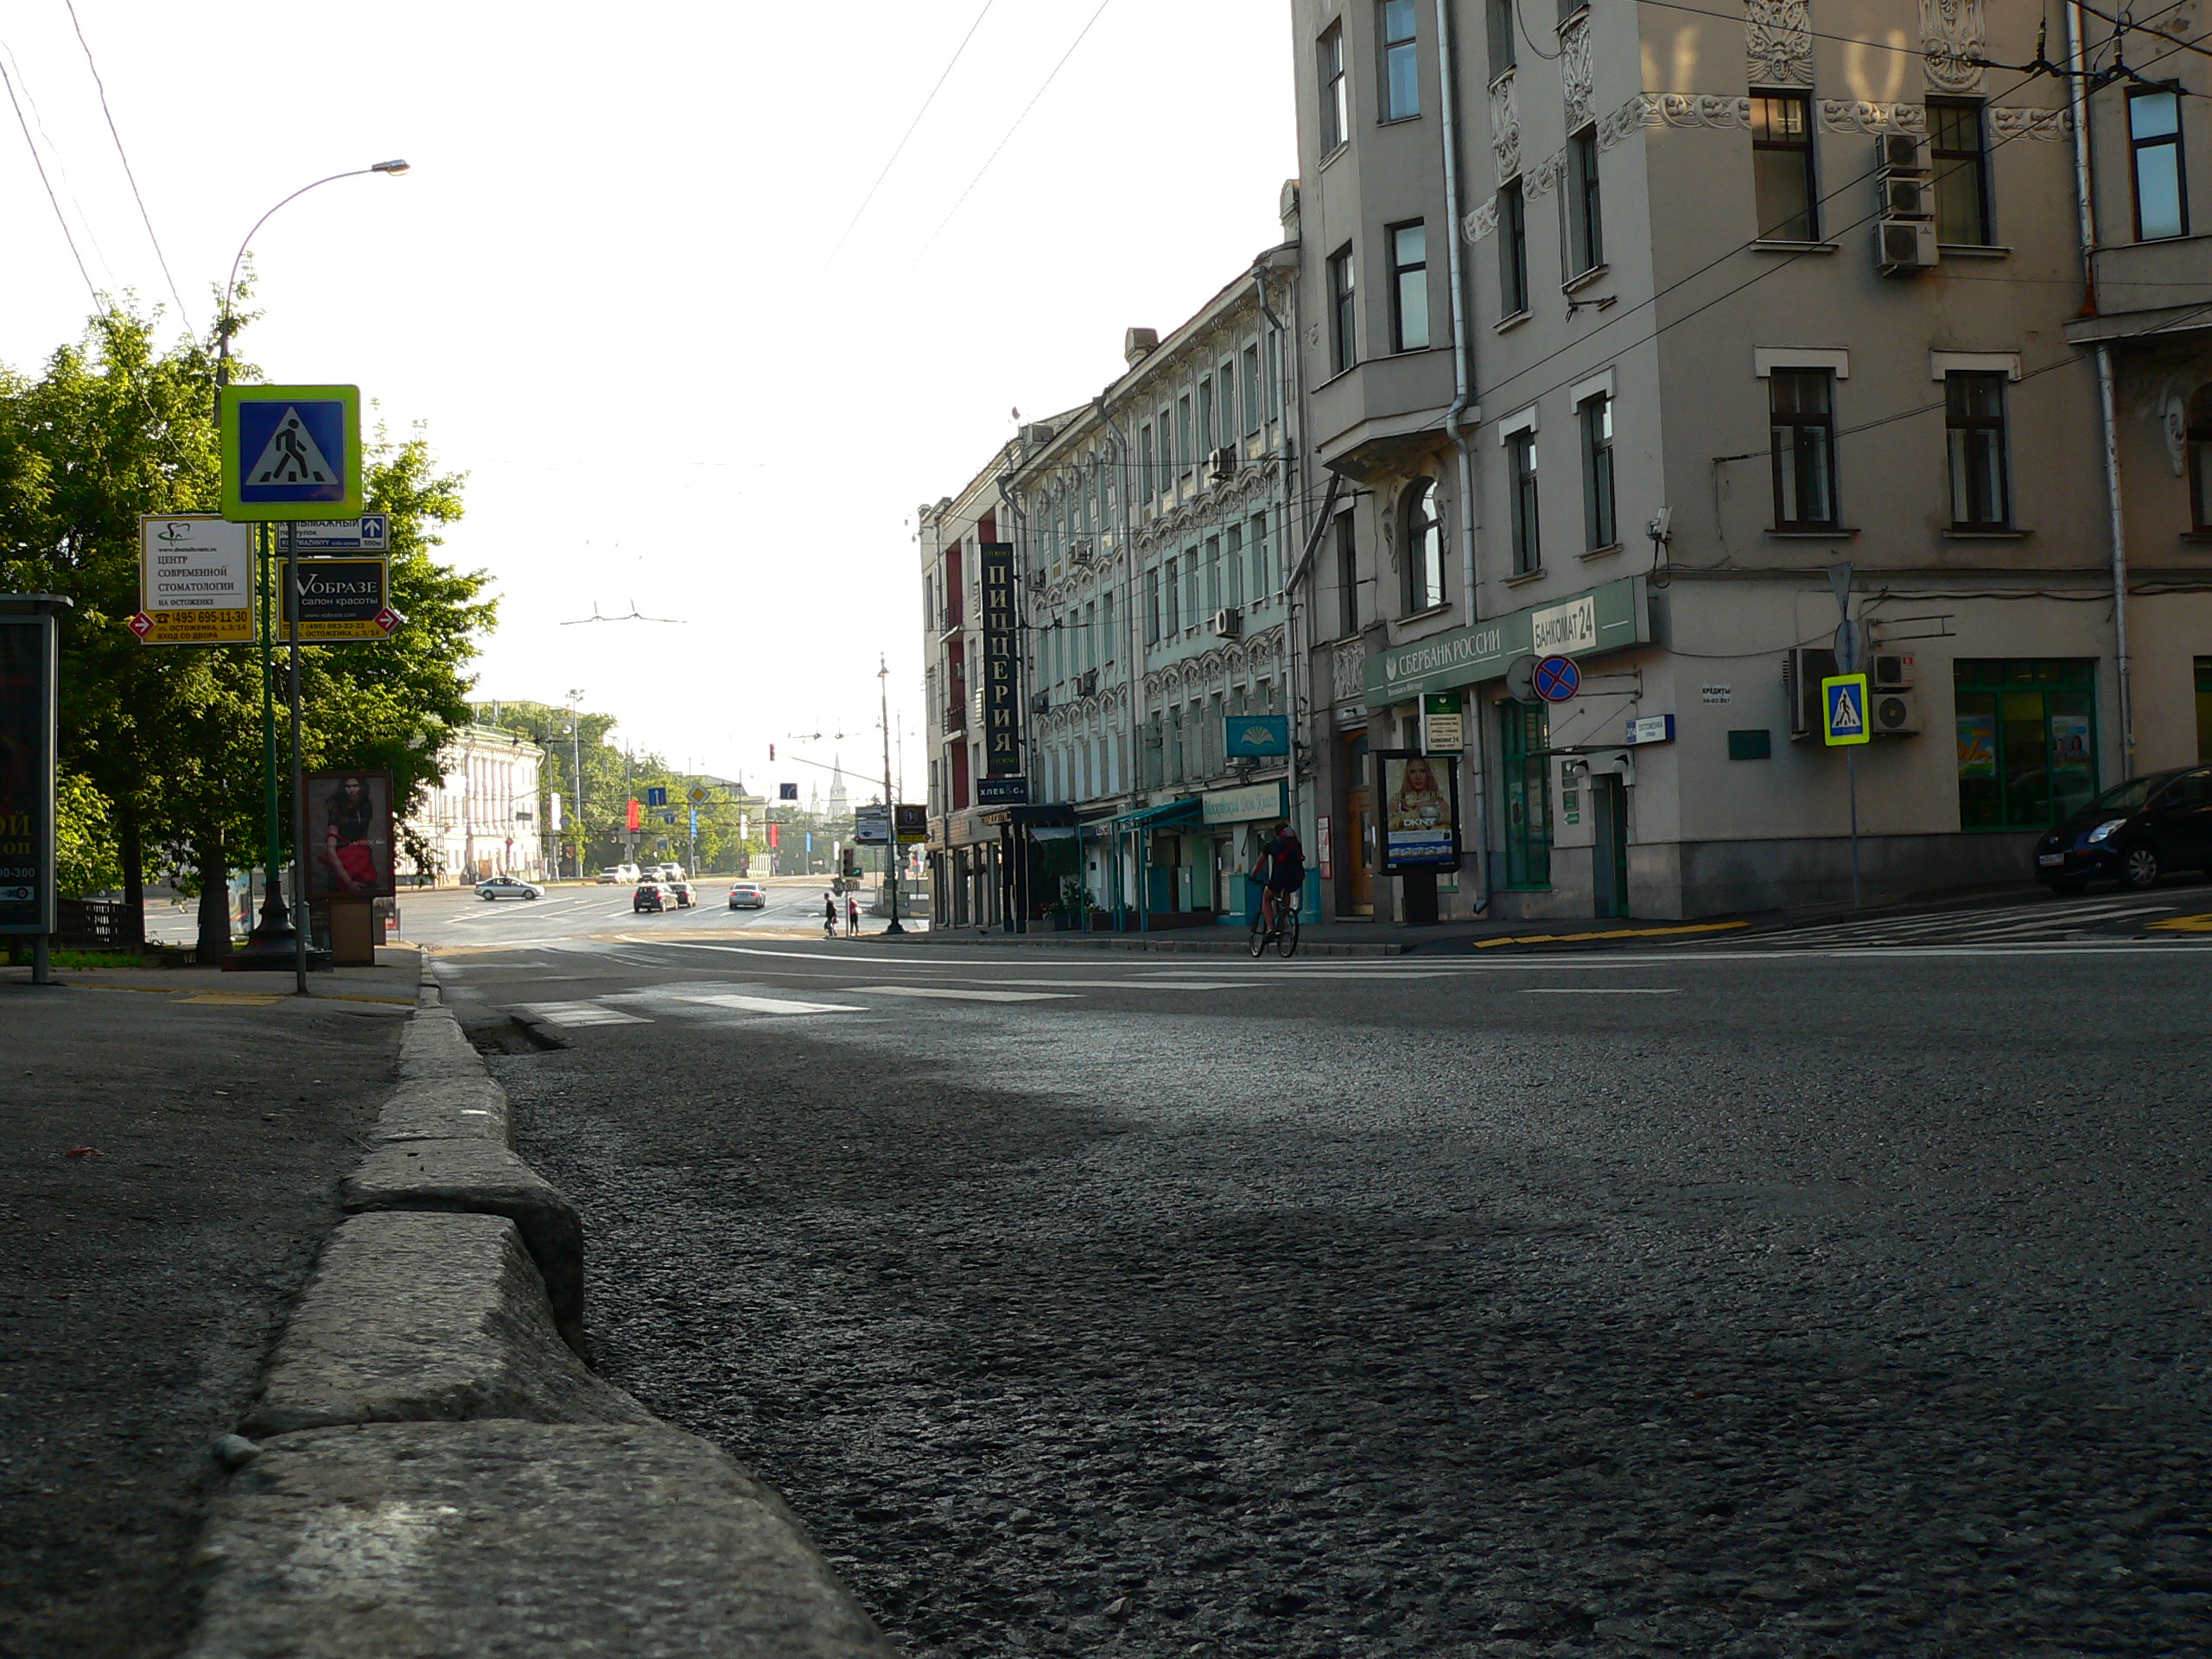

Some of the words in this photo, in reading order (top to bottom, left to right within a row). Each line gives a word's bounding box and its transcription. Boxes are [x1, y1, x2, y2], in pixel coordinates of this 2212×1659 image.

[158, 556, 188, 565] ЦЕНТР
[158, 566, 228, 578] СОВРЕМЕННОЙ
[158, 582, 234, 592] СТОМАТОЛОГИИ
[335, 597, 378, 607] красоты
[173, 612, 195, 623] (495)
[198, 611, 247, 623] 695-11-30
[1535, 613, 1578, 649] БАНКОМАТ
[1578, 603, 1593, 640] 24
[1399, 642, 1453, 677] СБЕРБАНК
[1453, 628, 1501, 662] РОССИИ
[988, 565, 1012, 753] ПИЦЦЕРИЯ
[1403, 818, 1436, 827] DKNY
